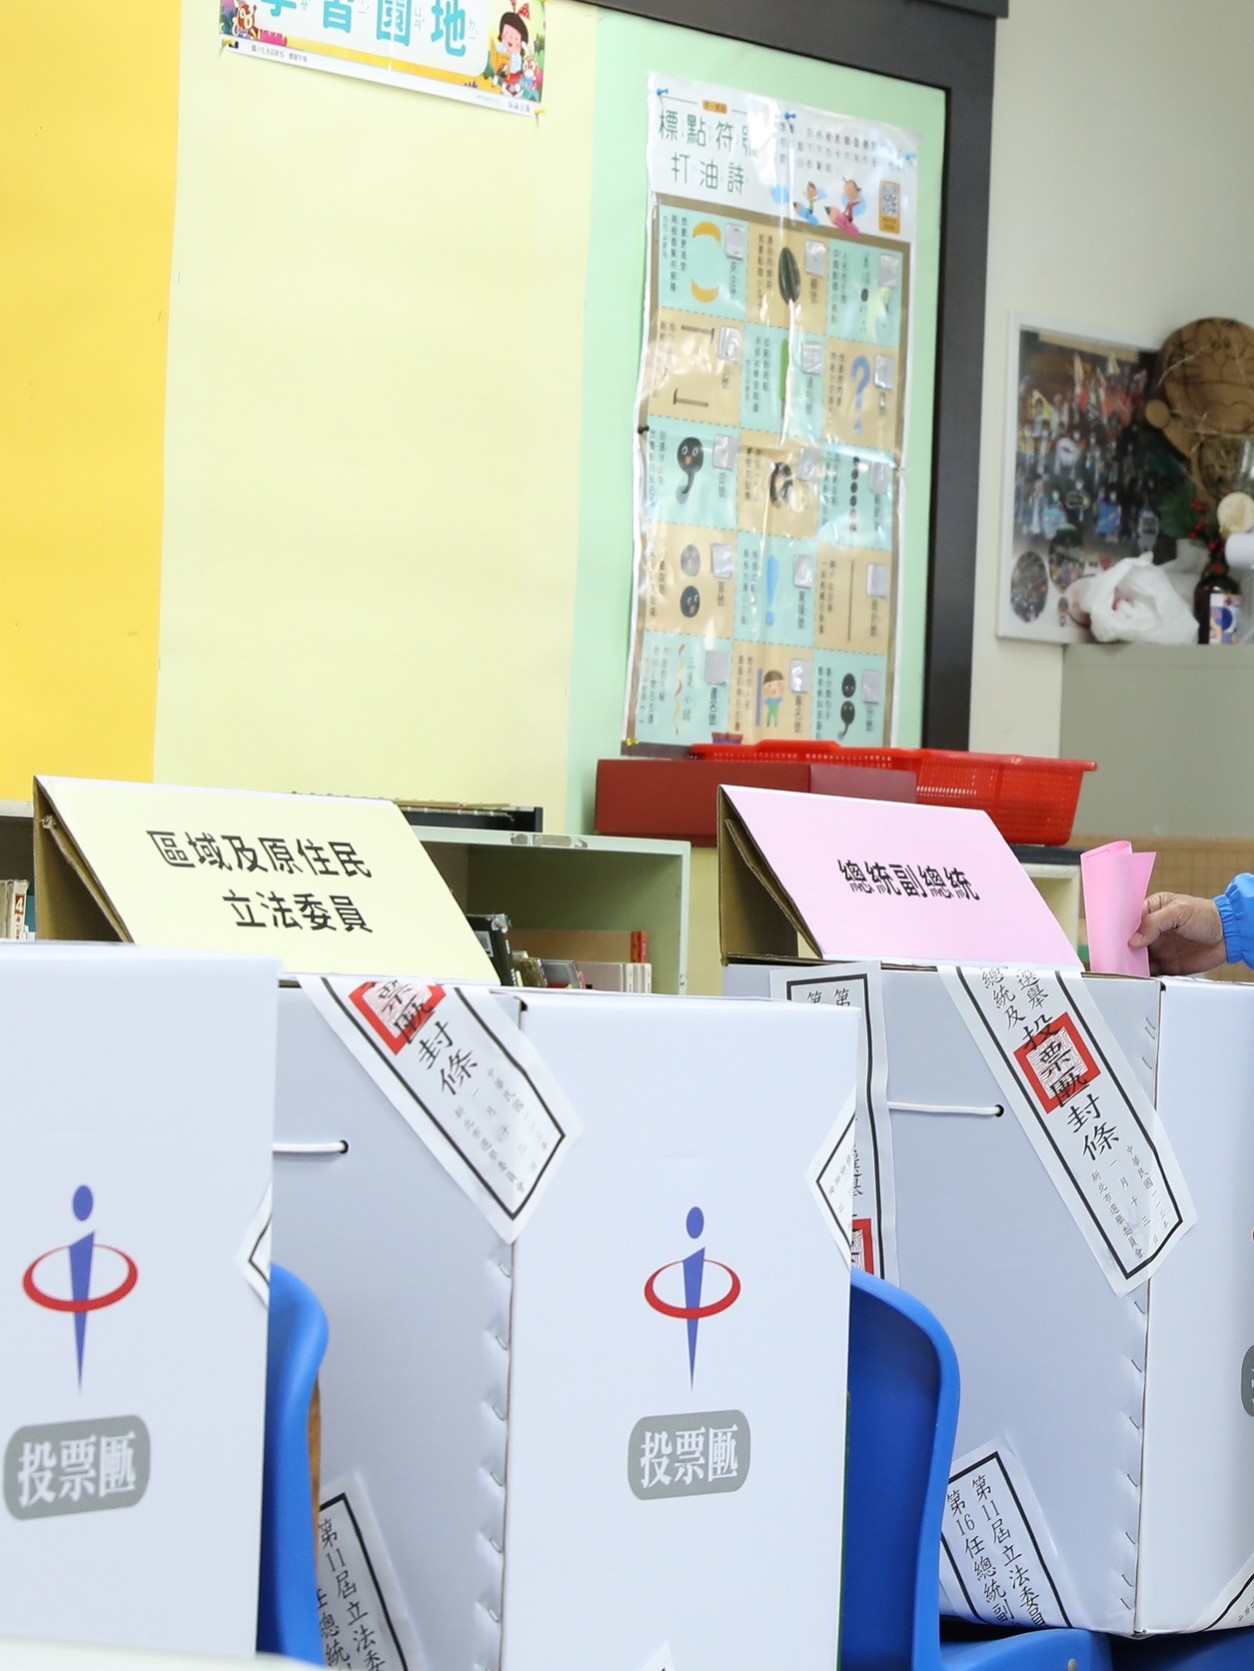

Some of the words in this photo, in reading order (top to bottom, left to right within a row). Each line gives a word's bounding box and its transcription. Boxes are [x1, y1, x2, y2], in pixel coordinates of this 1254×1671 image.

[671, 152, 745, 195] 打油詩
[146, 830, 372, 878] 區域及原住民
[837, 859, 980, 900] 總統副總統
[222, 888, 373, 933] 立法委員
[982, 967, 1026, 1030] 總統及
[369, 979, 479, 1096] 票匭封條
[1021, 1014, 1120, 1161] 投票匭封條
[17, 1431, 136, 1507] 投票匭
[640, 1424, 738, 1489] 投票匭
[972, 1474, 1047, 1627] 第11屆立法委員
